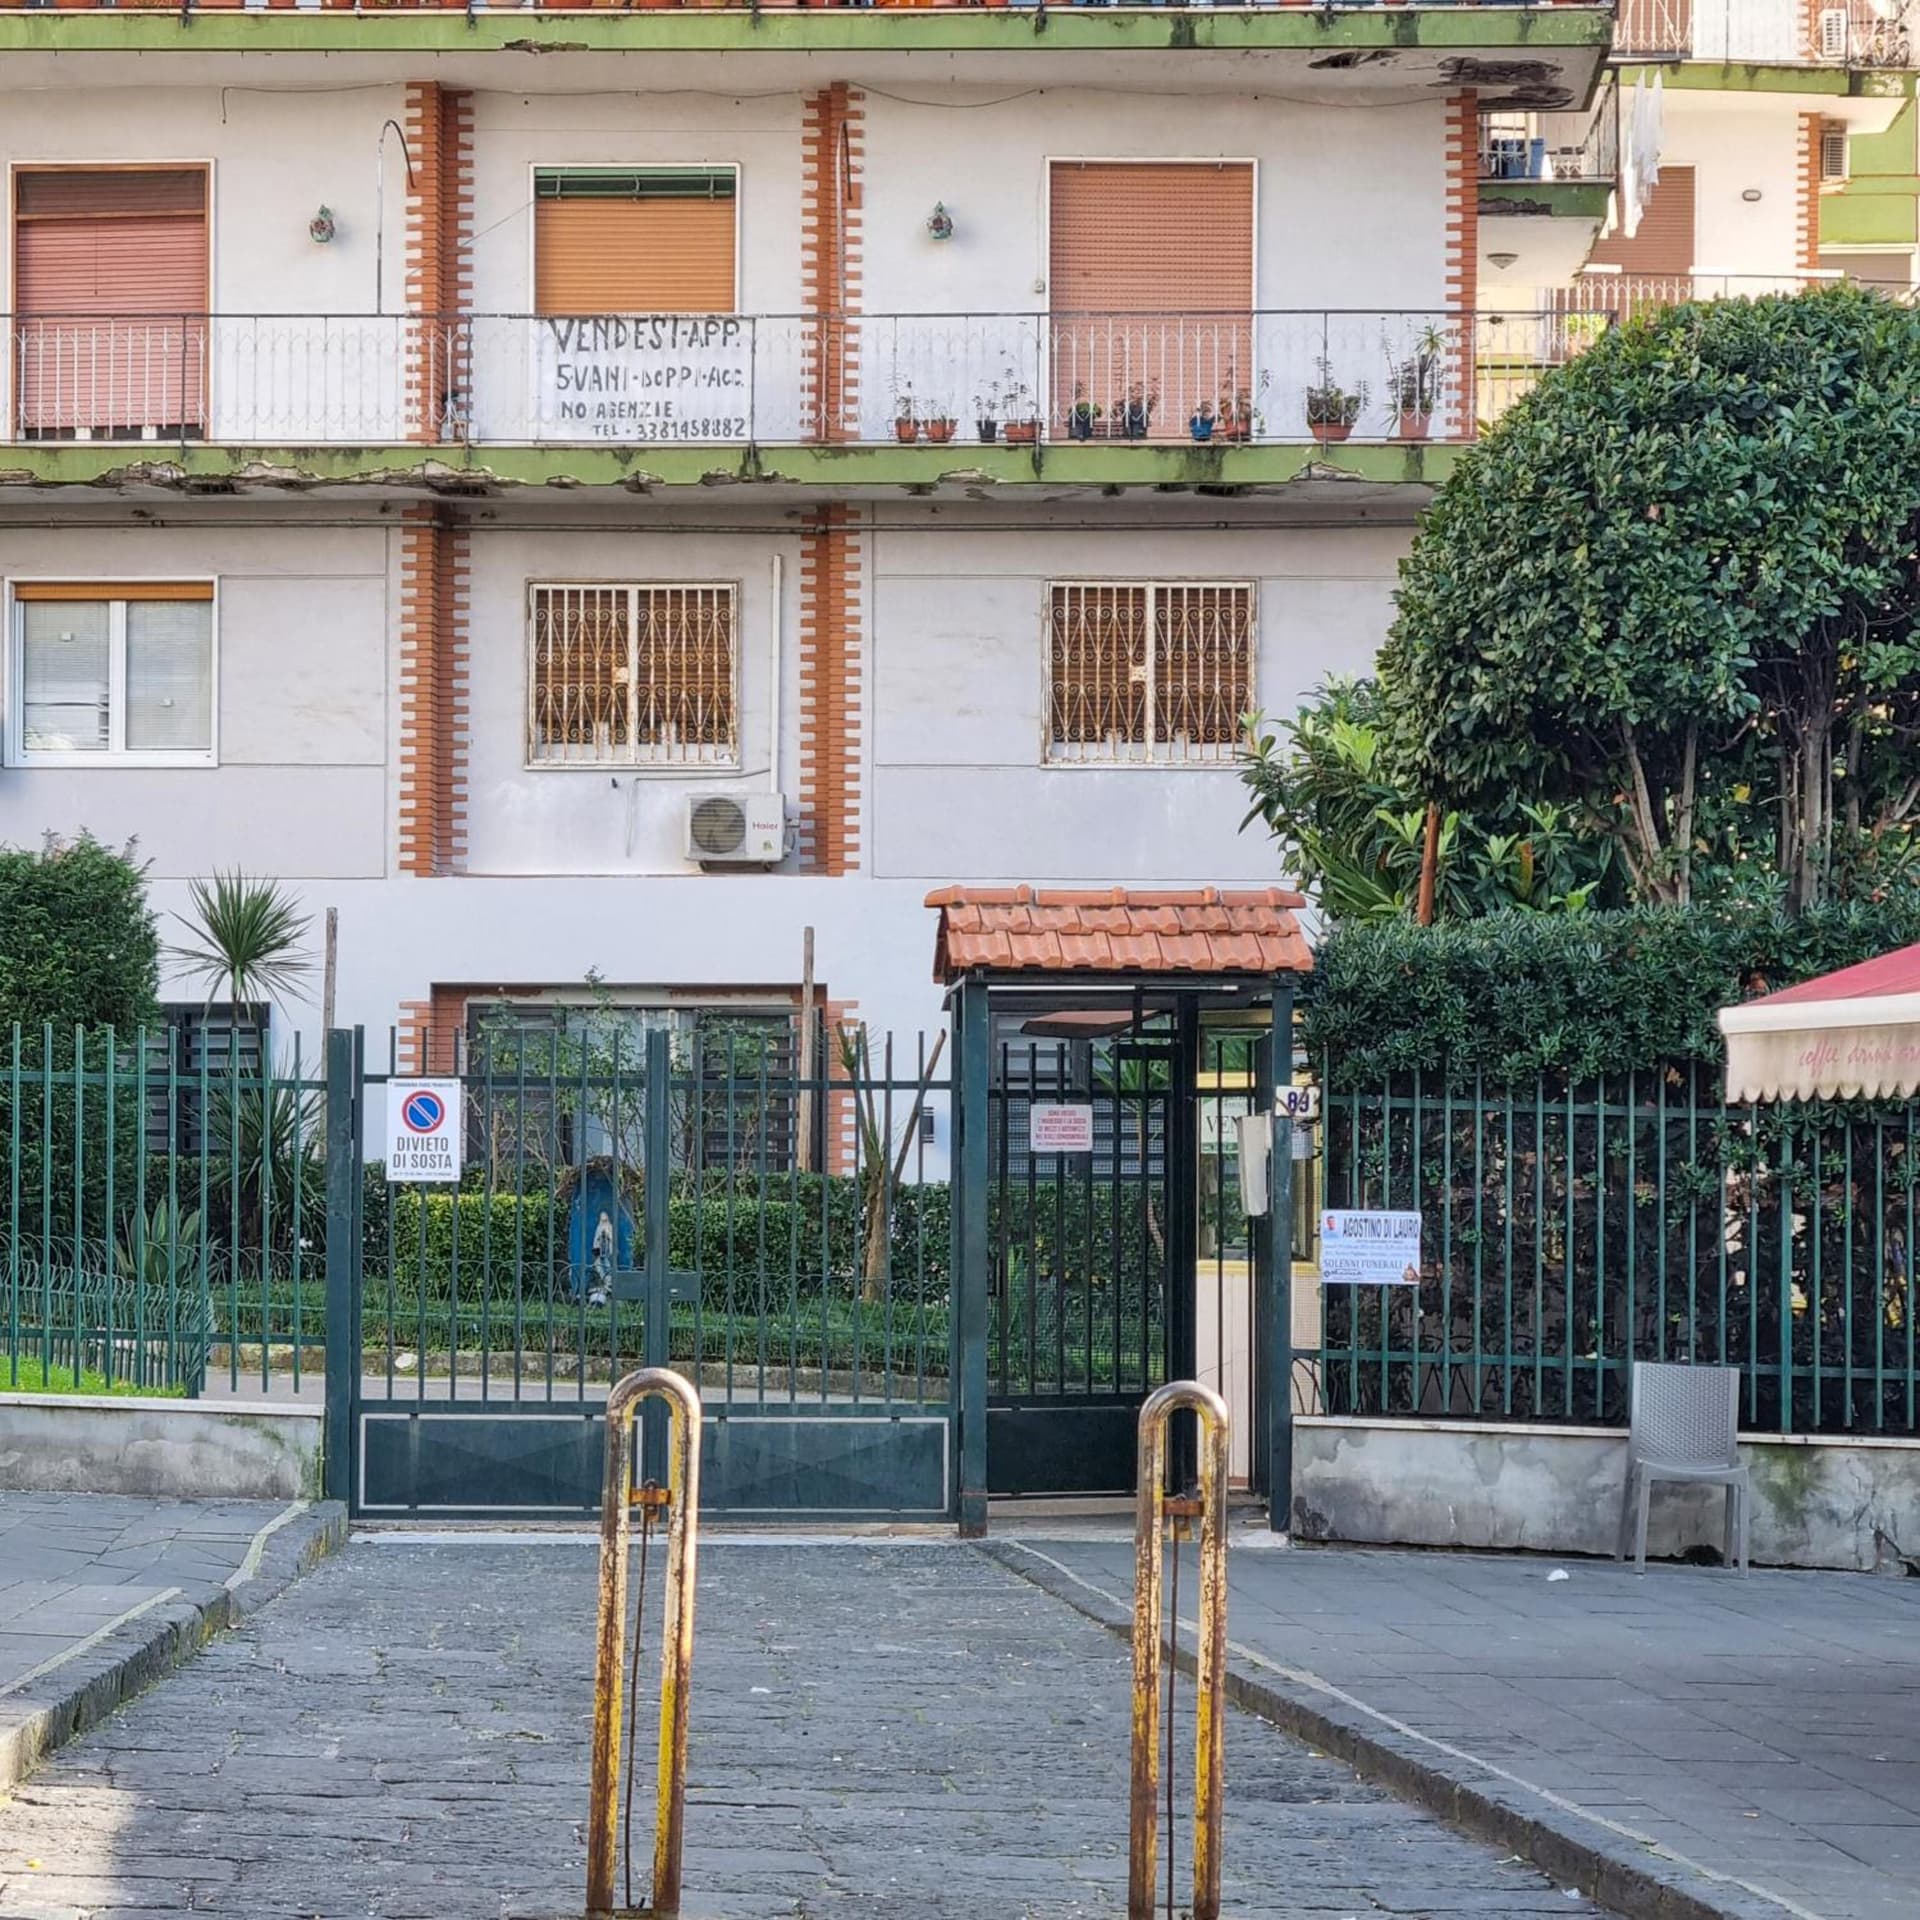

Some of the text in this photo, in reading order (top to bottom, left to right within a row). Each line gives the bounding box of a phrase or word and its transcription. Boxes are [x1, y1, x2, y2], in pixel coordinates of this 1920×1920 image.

[561, 401, 587, 419] NO
[752, 821, 778, 830] Haier
[1287, 1091, 1310, 1113] 89
[396, 1136, 449, 1152] DIVIETO
[393, 1153, 453, 1169] DI SOSTA
[1342, 1217, 1419, 1238] AGOSTINO DI LAURO
[1324, 1259, 1402, 1269] SOLENNI FUNERALI
